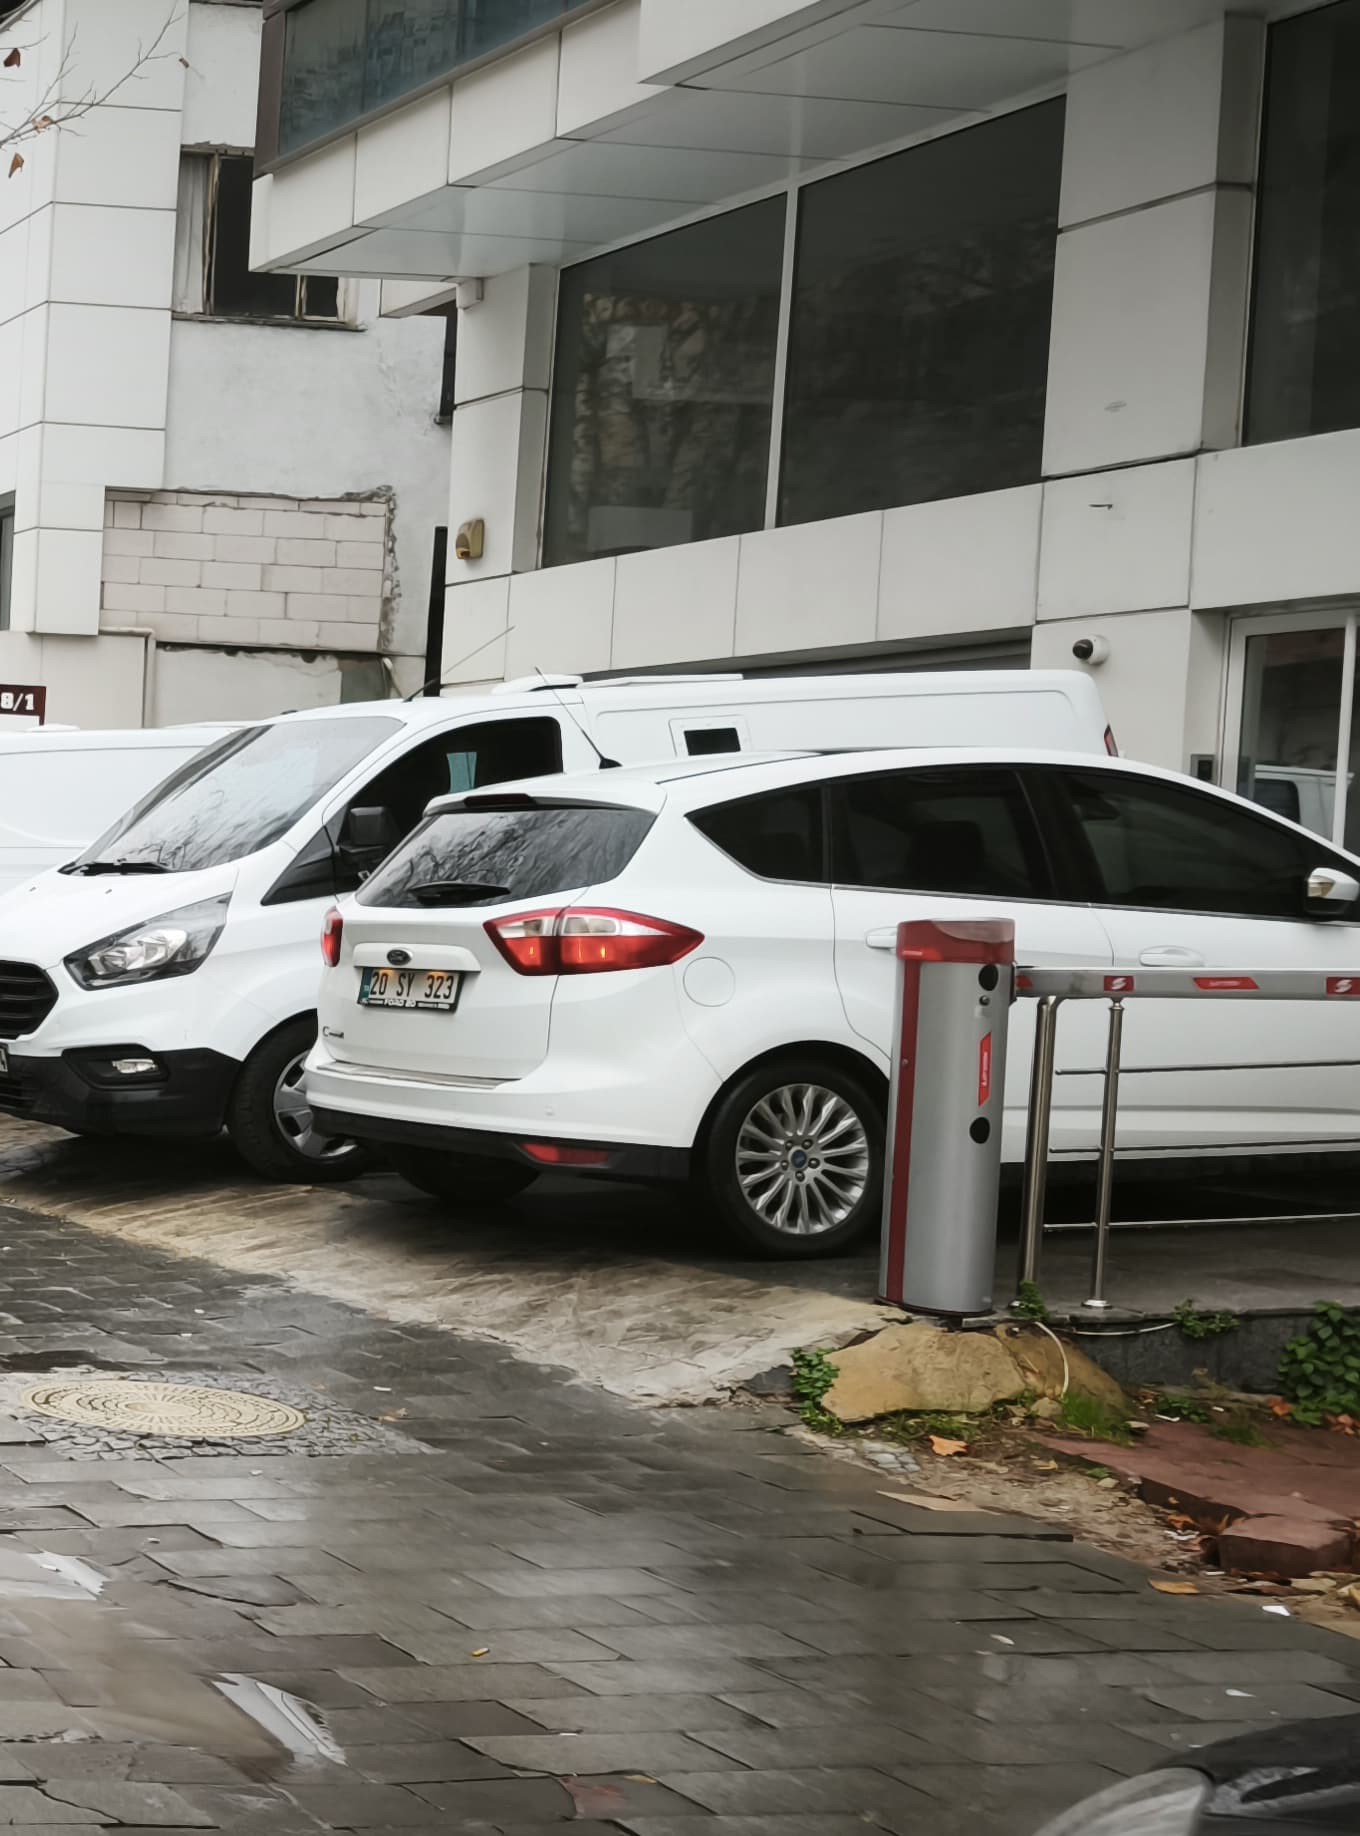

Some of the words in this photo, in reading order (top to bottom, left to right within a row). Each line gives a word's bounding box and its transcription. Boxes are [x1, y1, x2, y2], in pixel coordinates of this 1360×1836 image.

[370, 972, 389, 995] 20
[397, 973, 415, 997] SY
[425, 975, 454, 999] 323
